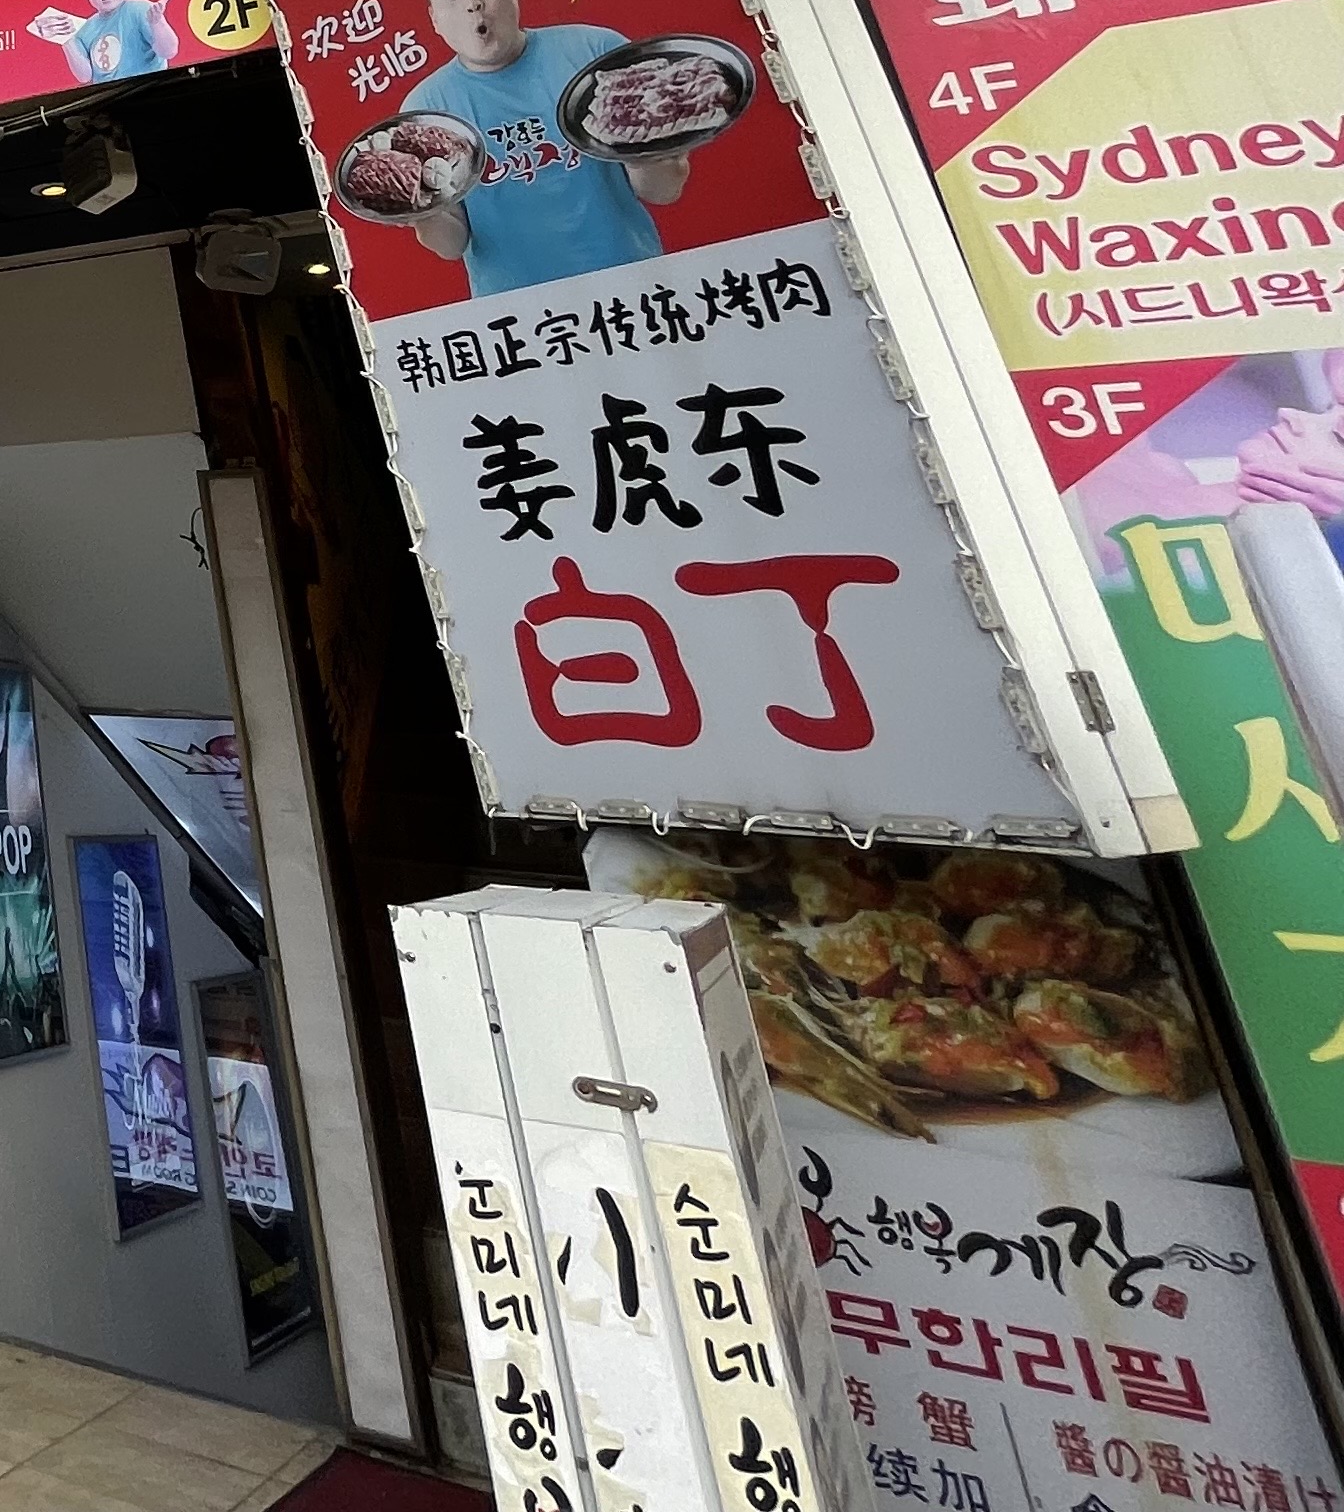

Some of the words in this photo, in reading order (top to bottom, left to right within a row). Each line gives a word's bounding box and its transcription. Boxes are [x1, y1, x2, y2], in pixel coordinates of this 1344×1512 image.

[348, 29, 430, 103] 光临
[928, 60, 1020, 117] 4F
[487, 115, 548, 149] 강호동
[971, 114, 1344, 202] Sydney
[996, 196, 1344, 278] Waxin
[395, 258, 832, 395] 韩国正宗传统烤肉
[1040, 380, 1146, 440] 3F
[462, 381, 821, 542] 姜虎东
[513, 555, 900, 753] 白丁
[673, 1182, 777, 1388] 순미네
[825, 1288, 1212, 1425] 무한리필
[865, 1441, 992, 1512] 续加
